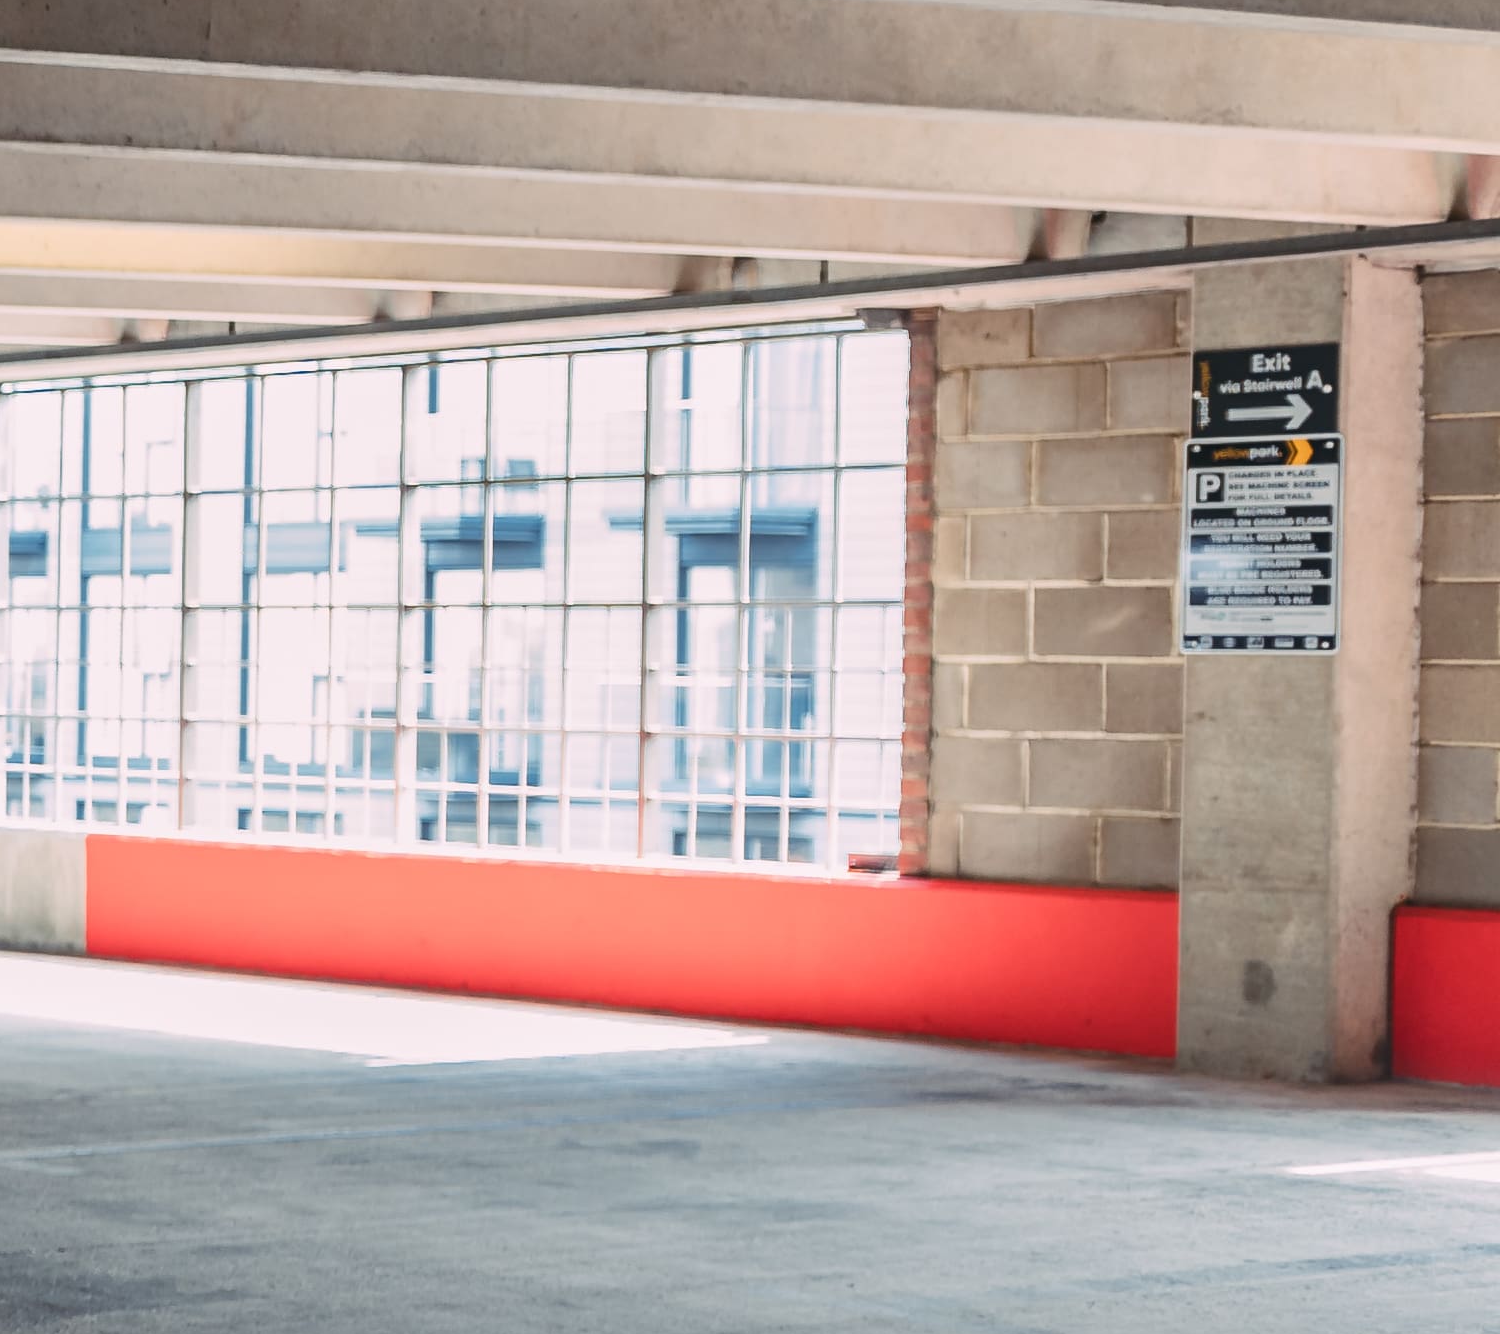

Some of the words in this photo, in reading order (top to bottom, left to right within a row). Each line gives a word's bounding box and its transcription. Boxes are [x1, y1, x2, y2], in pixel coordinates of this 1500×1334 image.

[1251, 352, 1292, 373] Exit
[1219, 380, 1241, 394] via
[1243, 376, 1303, 393] Stairwell
[1305, 369, 1324, 389] A
[1199, 474, 1221, 502] P
